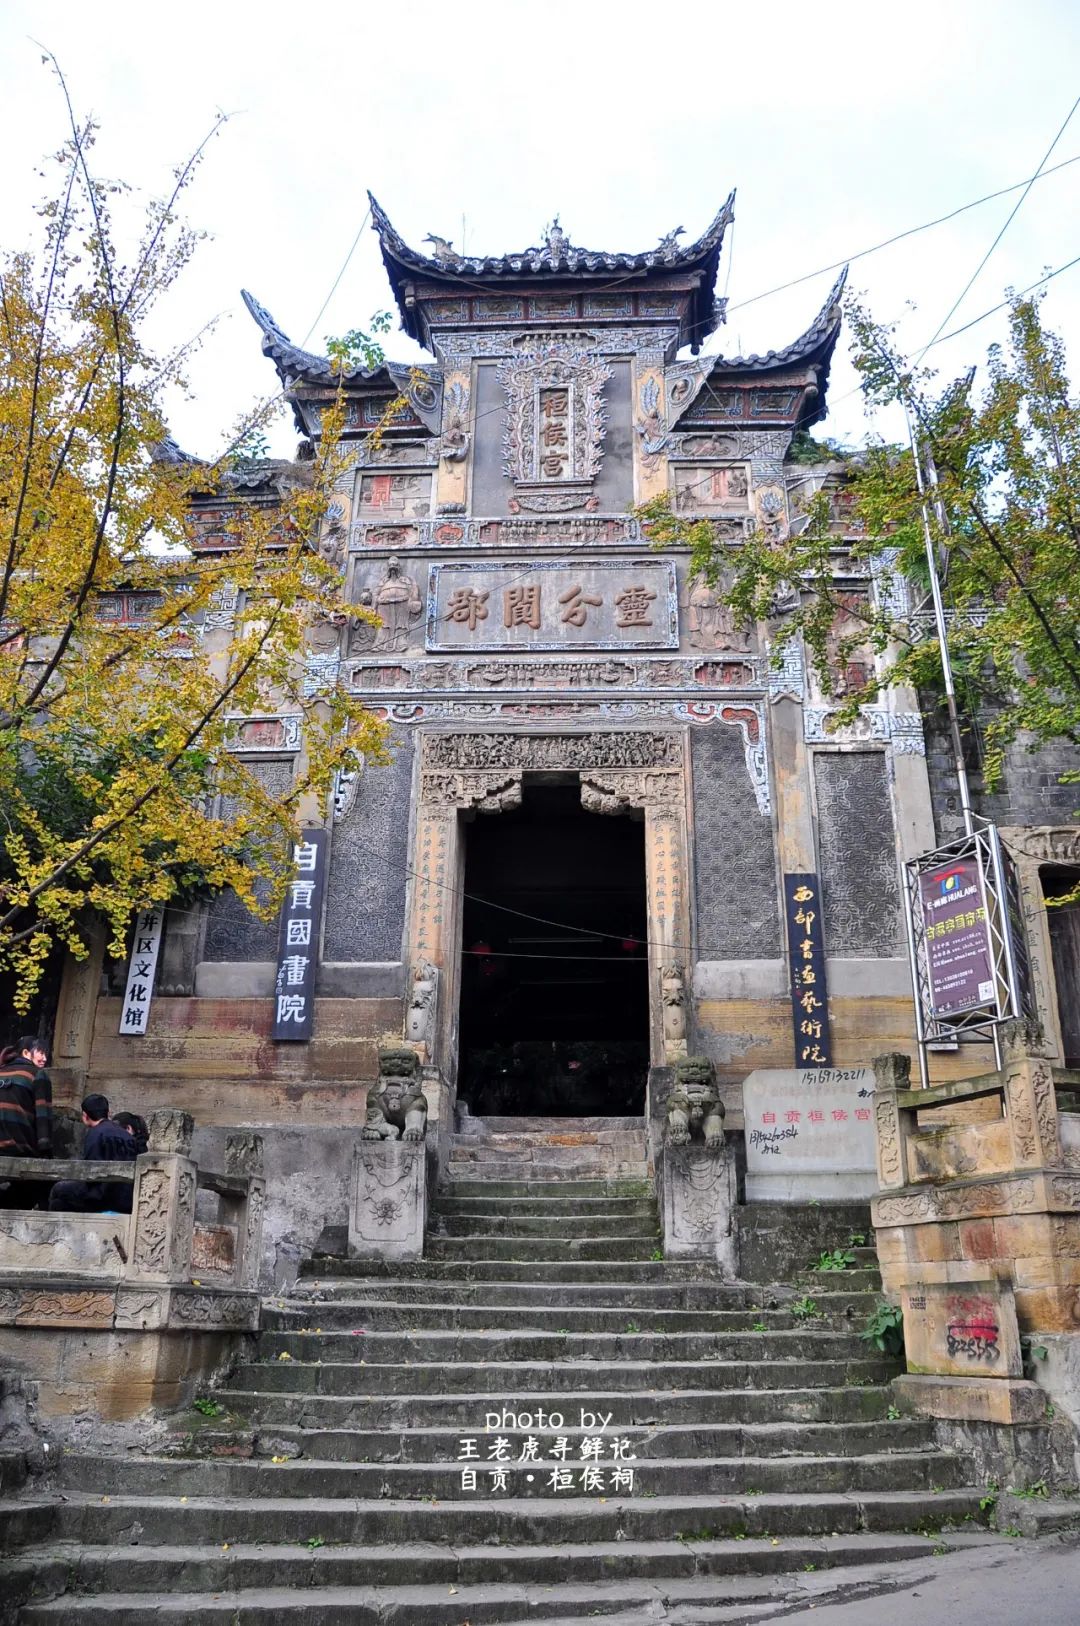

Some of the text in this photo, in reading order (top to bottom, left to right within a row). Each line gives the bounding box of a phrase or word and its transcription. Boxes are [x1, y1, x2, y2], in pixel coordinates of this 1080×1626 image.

[124, 913, 159, 1027] 井区文化馆
[762, 1108, 871, 1124] 自贡桓侯宫
